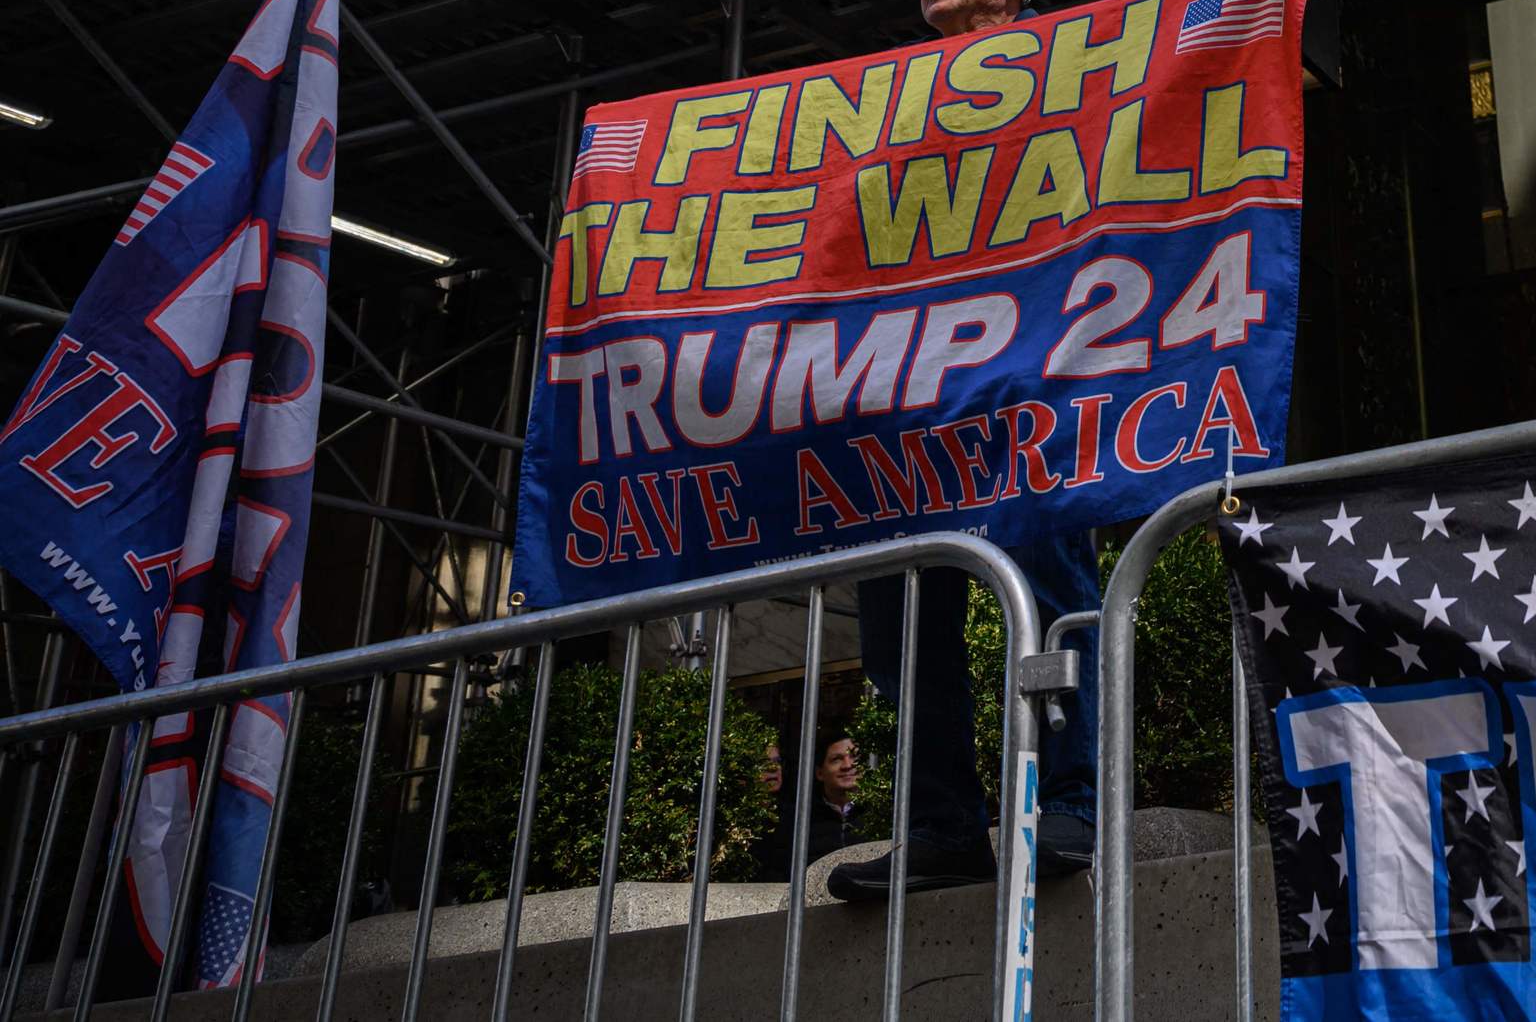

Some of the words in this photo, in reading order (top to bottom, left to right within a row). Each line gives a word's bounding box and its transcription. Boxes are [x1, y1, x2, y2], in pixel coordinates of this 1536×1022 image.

[556, 184, 815, 307] THE
[855, 81, 1288, 268] WALL
[549, 292, 1020, 464] TRUMP
[1043, 229, 1265, 380] 24
[565, 464, 760, 568] SAVE
[793, 365, 1270, 537] AMERICA
